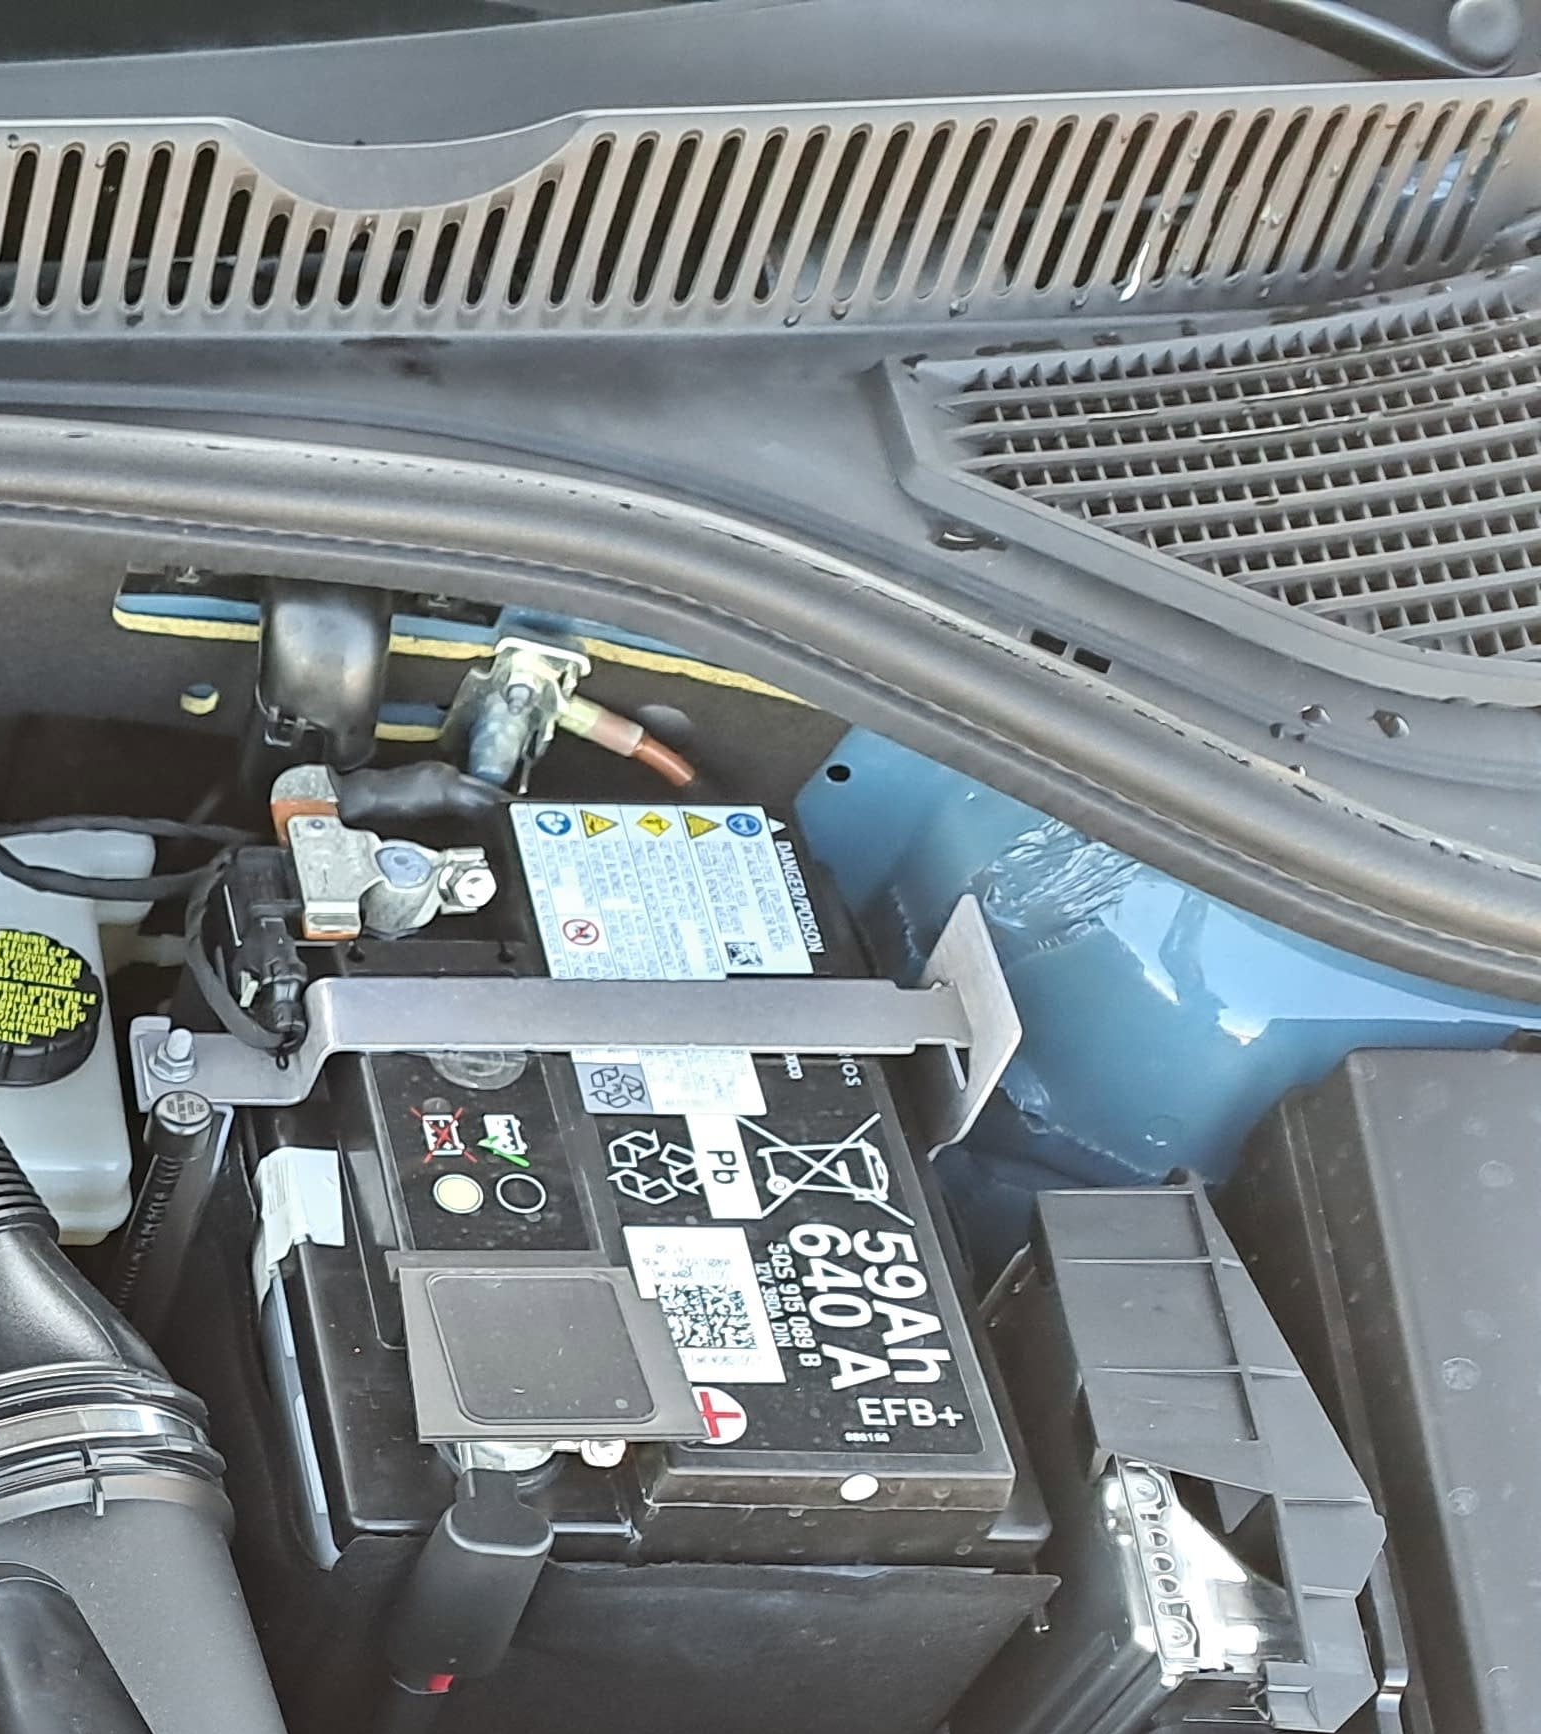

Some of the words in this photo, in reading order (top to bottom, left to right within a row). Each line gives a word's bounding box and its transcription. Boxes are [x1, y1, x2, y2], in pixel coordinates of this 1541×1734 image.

[775, 840, 826, 954] DANGER/POISON
[83, 993, 96, 1005] LE
[708, 1149, 741, 1185] Pb
[755, 1262, 775, 1284] 12V
[770, 1321, 794, 1348] DIN
[789, 1223, 873, 1328] 640
[853, 1229, 952, 1384] 59Ah
[779, 1283, 807, 1313] 915
[798, 1353, 822, 1367] B
[821, 1343, 891, 1391] A
[856, 1397, 964, 1428] EFB+
